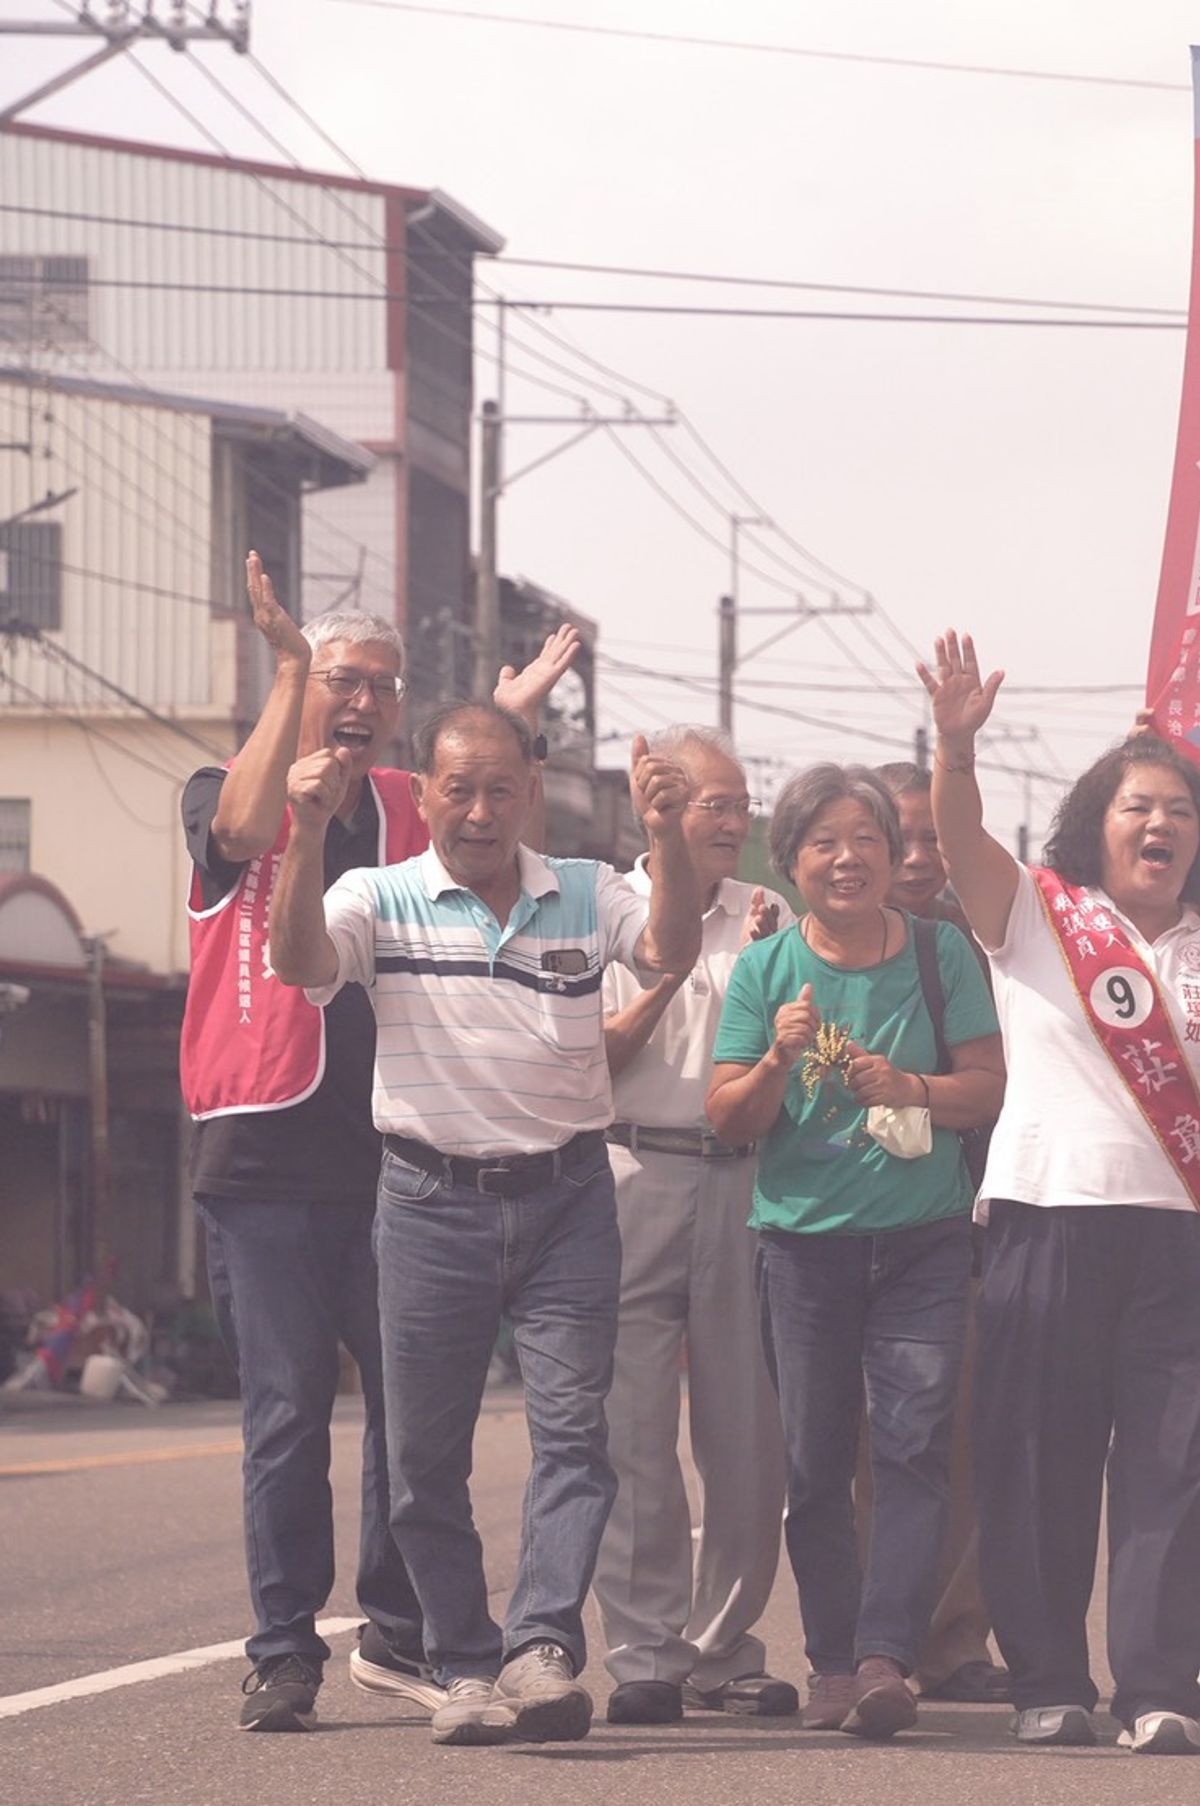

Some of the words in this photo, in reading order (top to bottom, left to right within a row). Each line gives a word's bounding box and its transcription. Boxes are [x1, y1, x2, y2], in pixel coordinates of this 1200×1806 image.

[238, 855, 263, 1024] 東縣第二選區議員候選人
[1106, 975, 1136, 1019] 9
